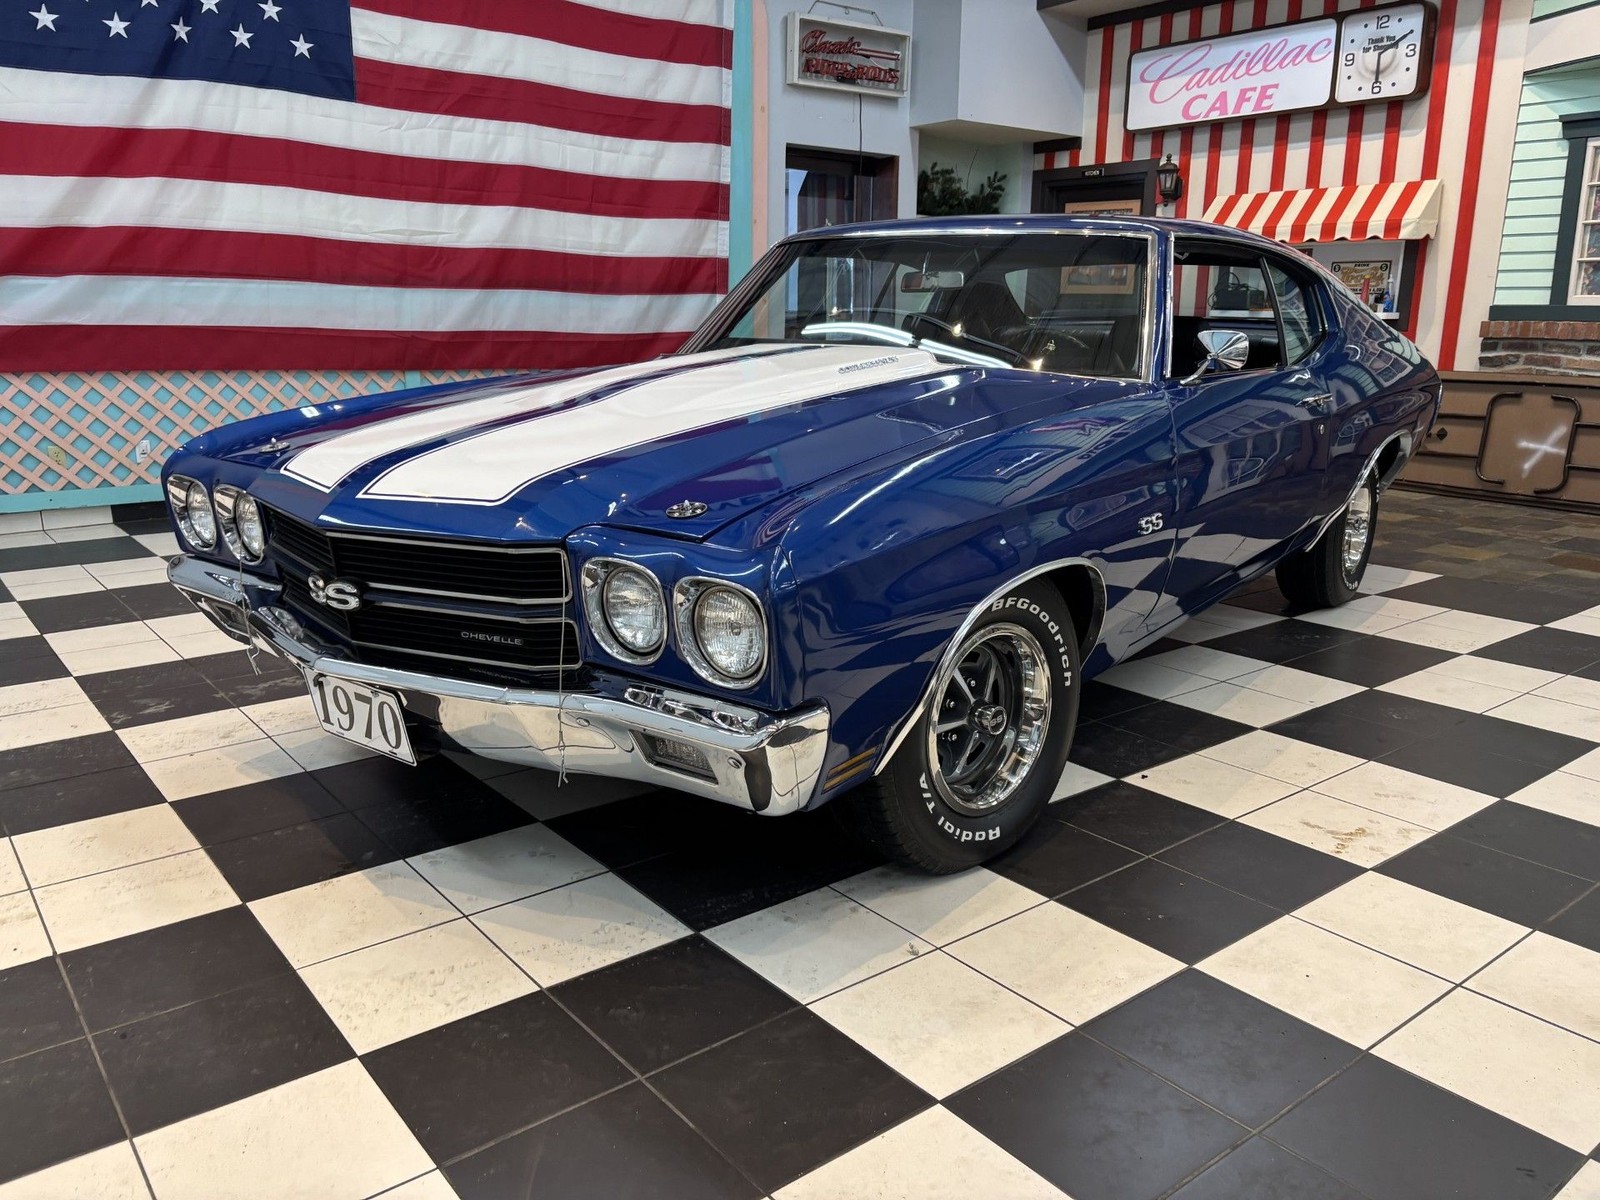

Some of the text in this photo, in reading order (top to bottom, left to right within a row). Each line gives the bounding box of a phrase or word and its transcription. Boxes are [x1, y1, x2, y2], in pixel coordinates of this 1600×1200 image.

[1375, 14, 1391, 30] 12
[1368, 36, 1385, 45] Thank
[1344, 52, 1355, 67] 9
[1405, 43, 1417, 58] 3
[1139, 38, 1333, 104] Cadillac
[1371, 80, 1382, 95] 6
[1181, 83, 1280, 121] CAFE
[1138, 512, 1163, 535] SS
[461, 631, 523, 646] CHEVELLE
[991, 597, 1072, 687] BFGoodrich
[313, 673, 402, 750] 1970
[919, 772, 1001, 843] Radial T/A
